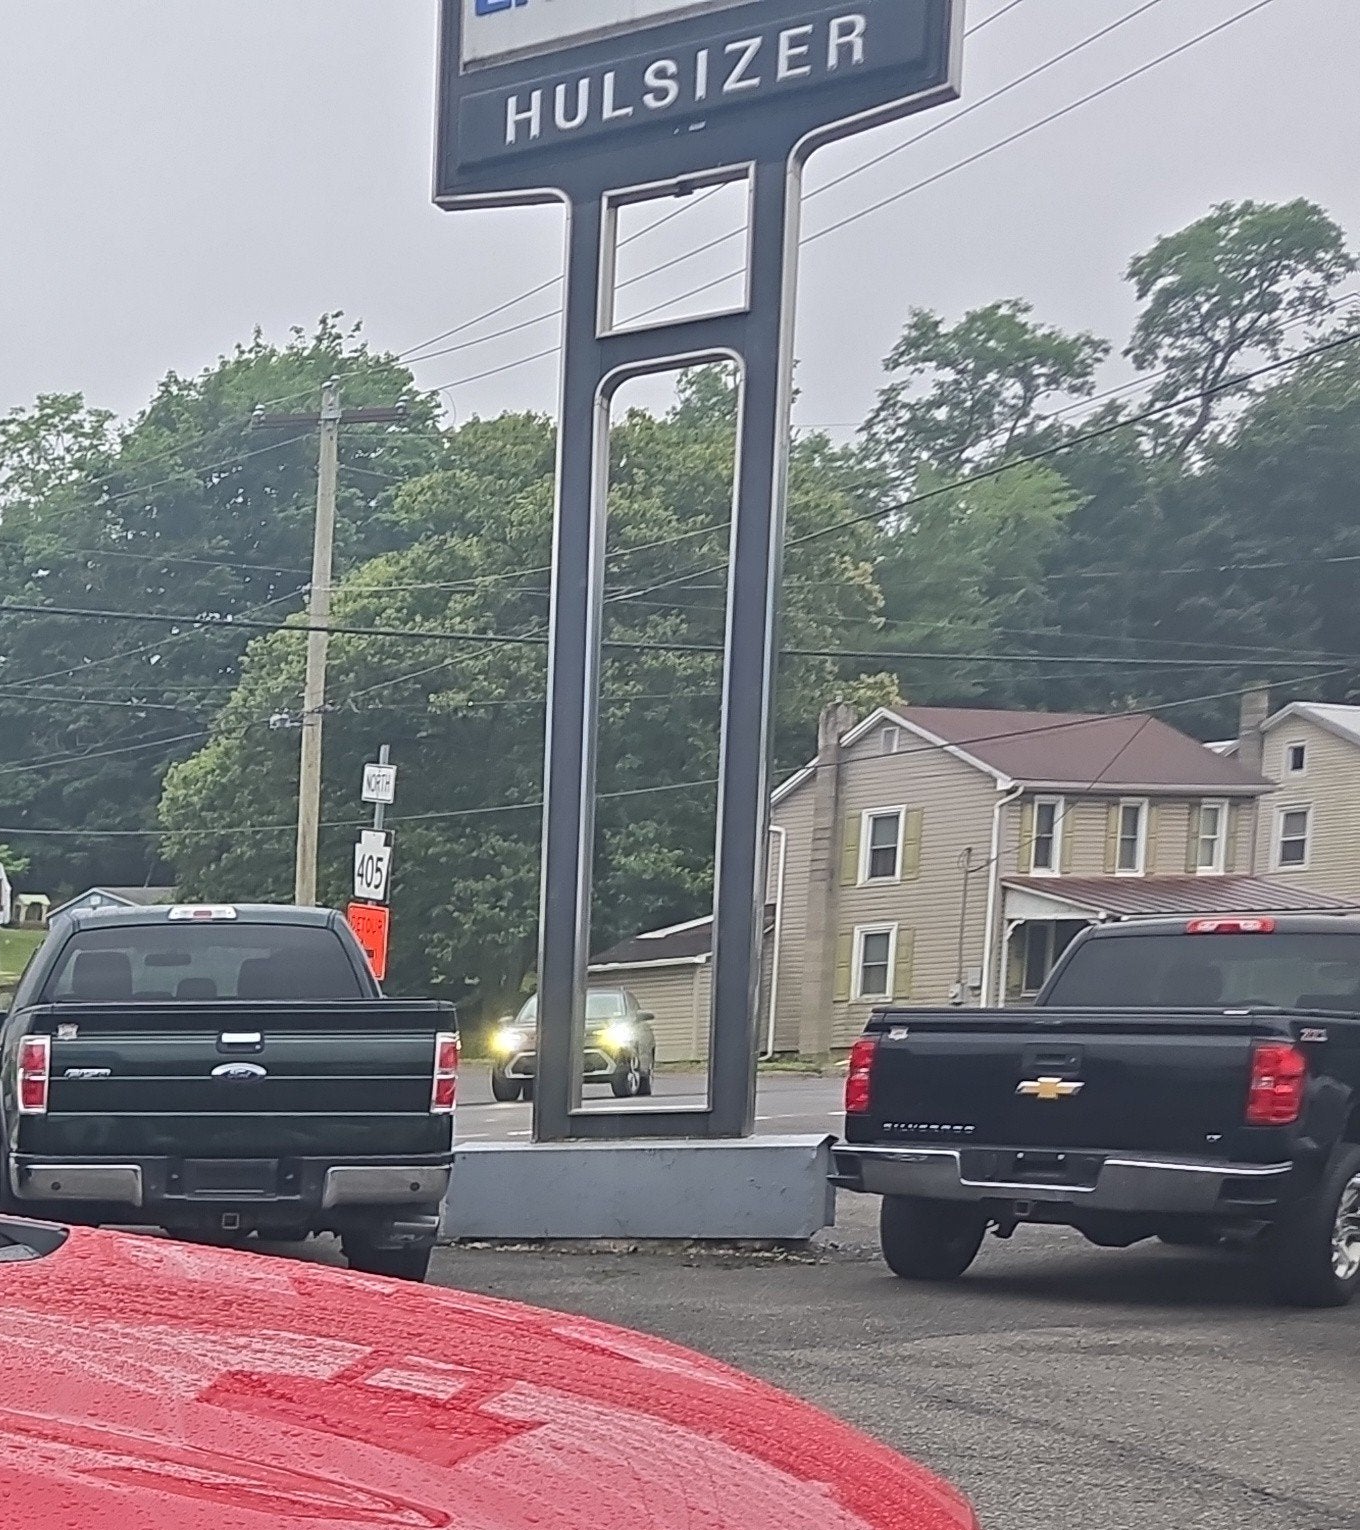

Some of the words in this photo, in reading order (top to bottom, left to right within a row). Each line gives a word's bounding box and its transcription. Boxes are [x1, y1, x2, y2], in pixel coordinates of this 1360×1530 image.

[504, 13, 868, 145] HULSIZER
[367, 773, 391, 792] NORTH
[357, 853, 384, 890] 405
